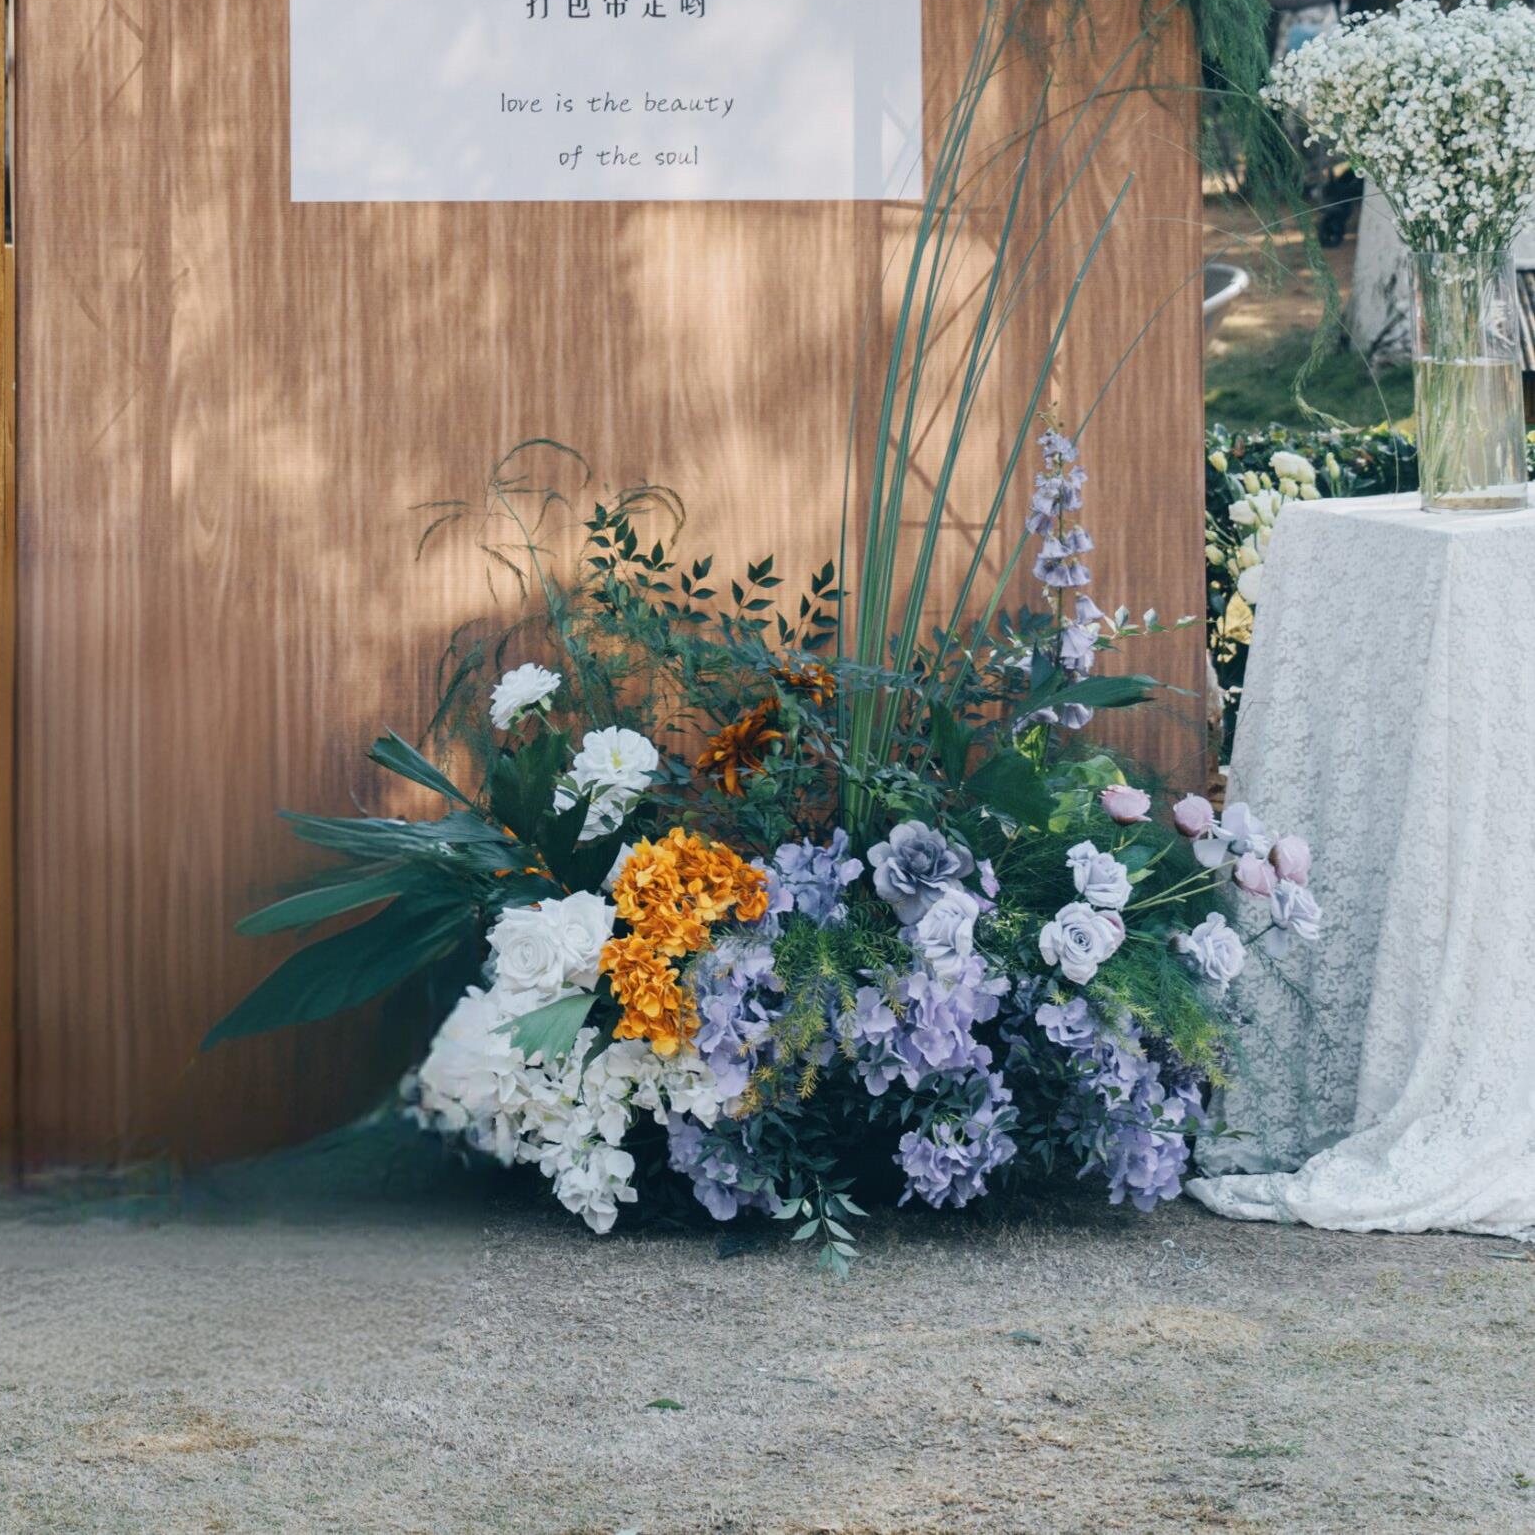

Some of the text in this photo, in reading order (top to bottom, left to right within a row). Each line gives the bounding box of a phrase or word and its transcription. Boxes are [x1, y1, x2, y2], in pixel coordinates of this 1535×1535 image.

[500, 90, 735, 120] love is the beauty
[558, 144, 699, 171] of the soul
